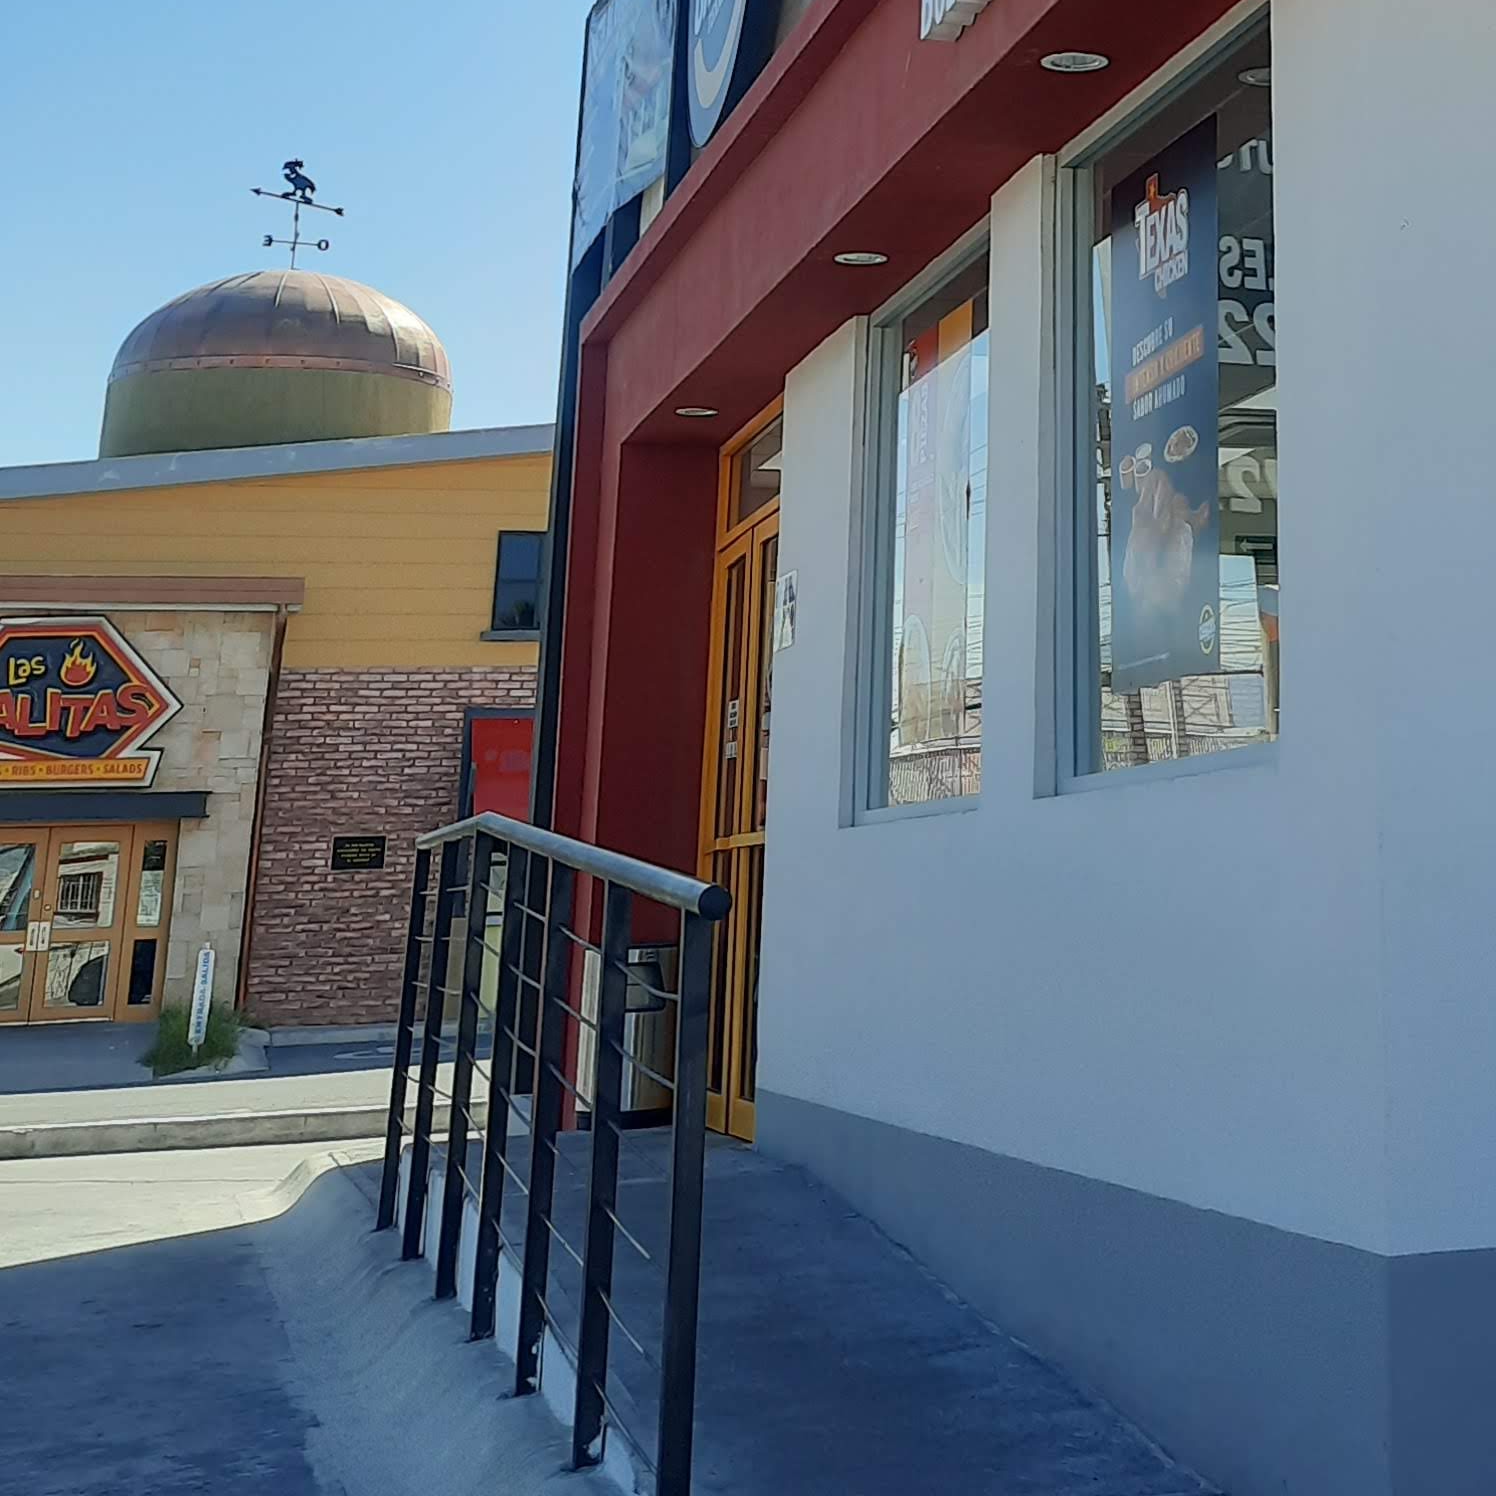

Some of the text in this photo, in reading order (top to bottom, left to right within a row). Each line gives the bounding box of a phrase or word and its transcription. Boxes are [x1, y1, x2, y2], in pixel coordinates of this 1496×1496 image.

[1135, 188, 1188, 280] TEXAS
[8, 656, 46, 686] Las
[12, 763, 143, 775] RIBS BURGERS SALADS
